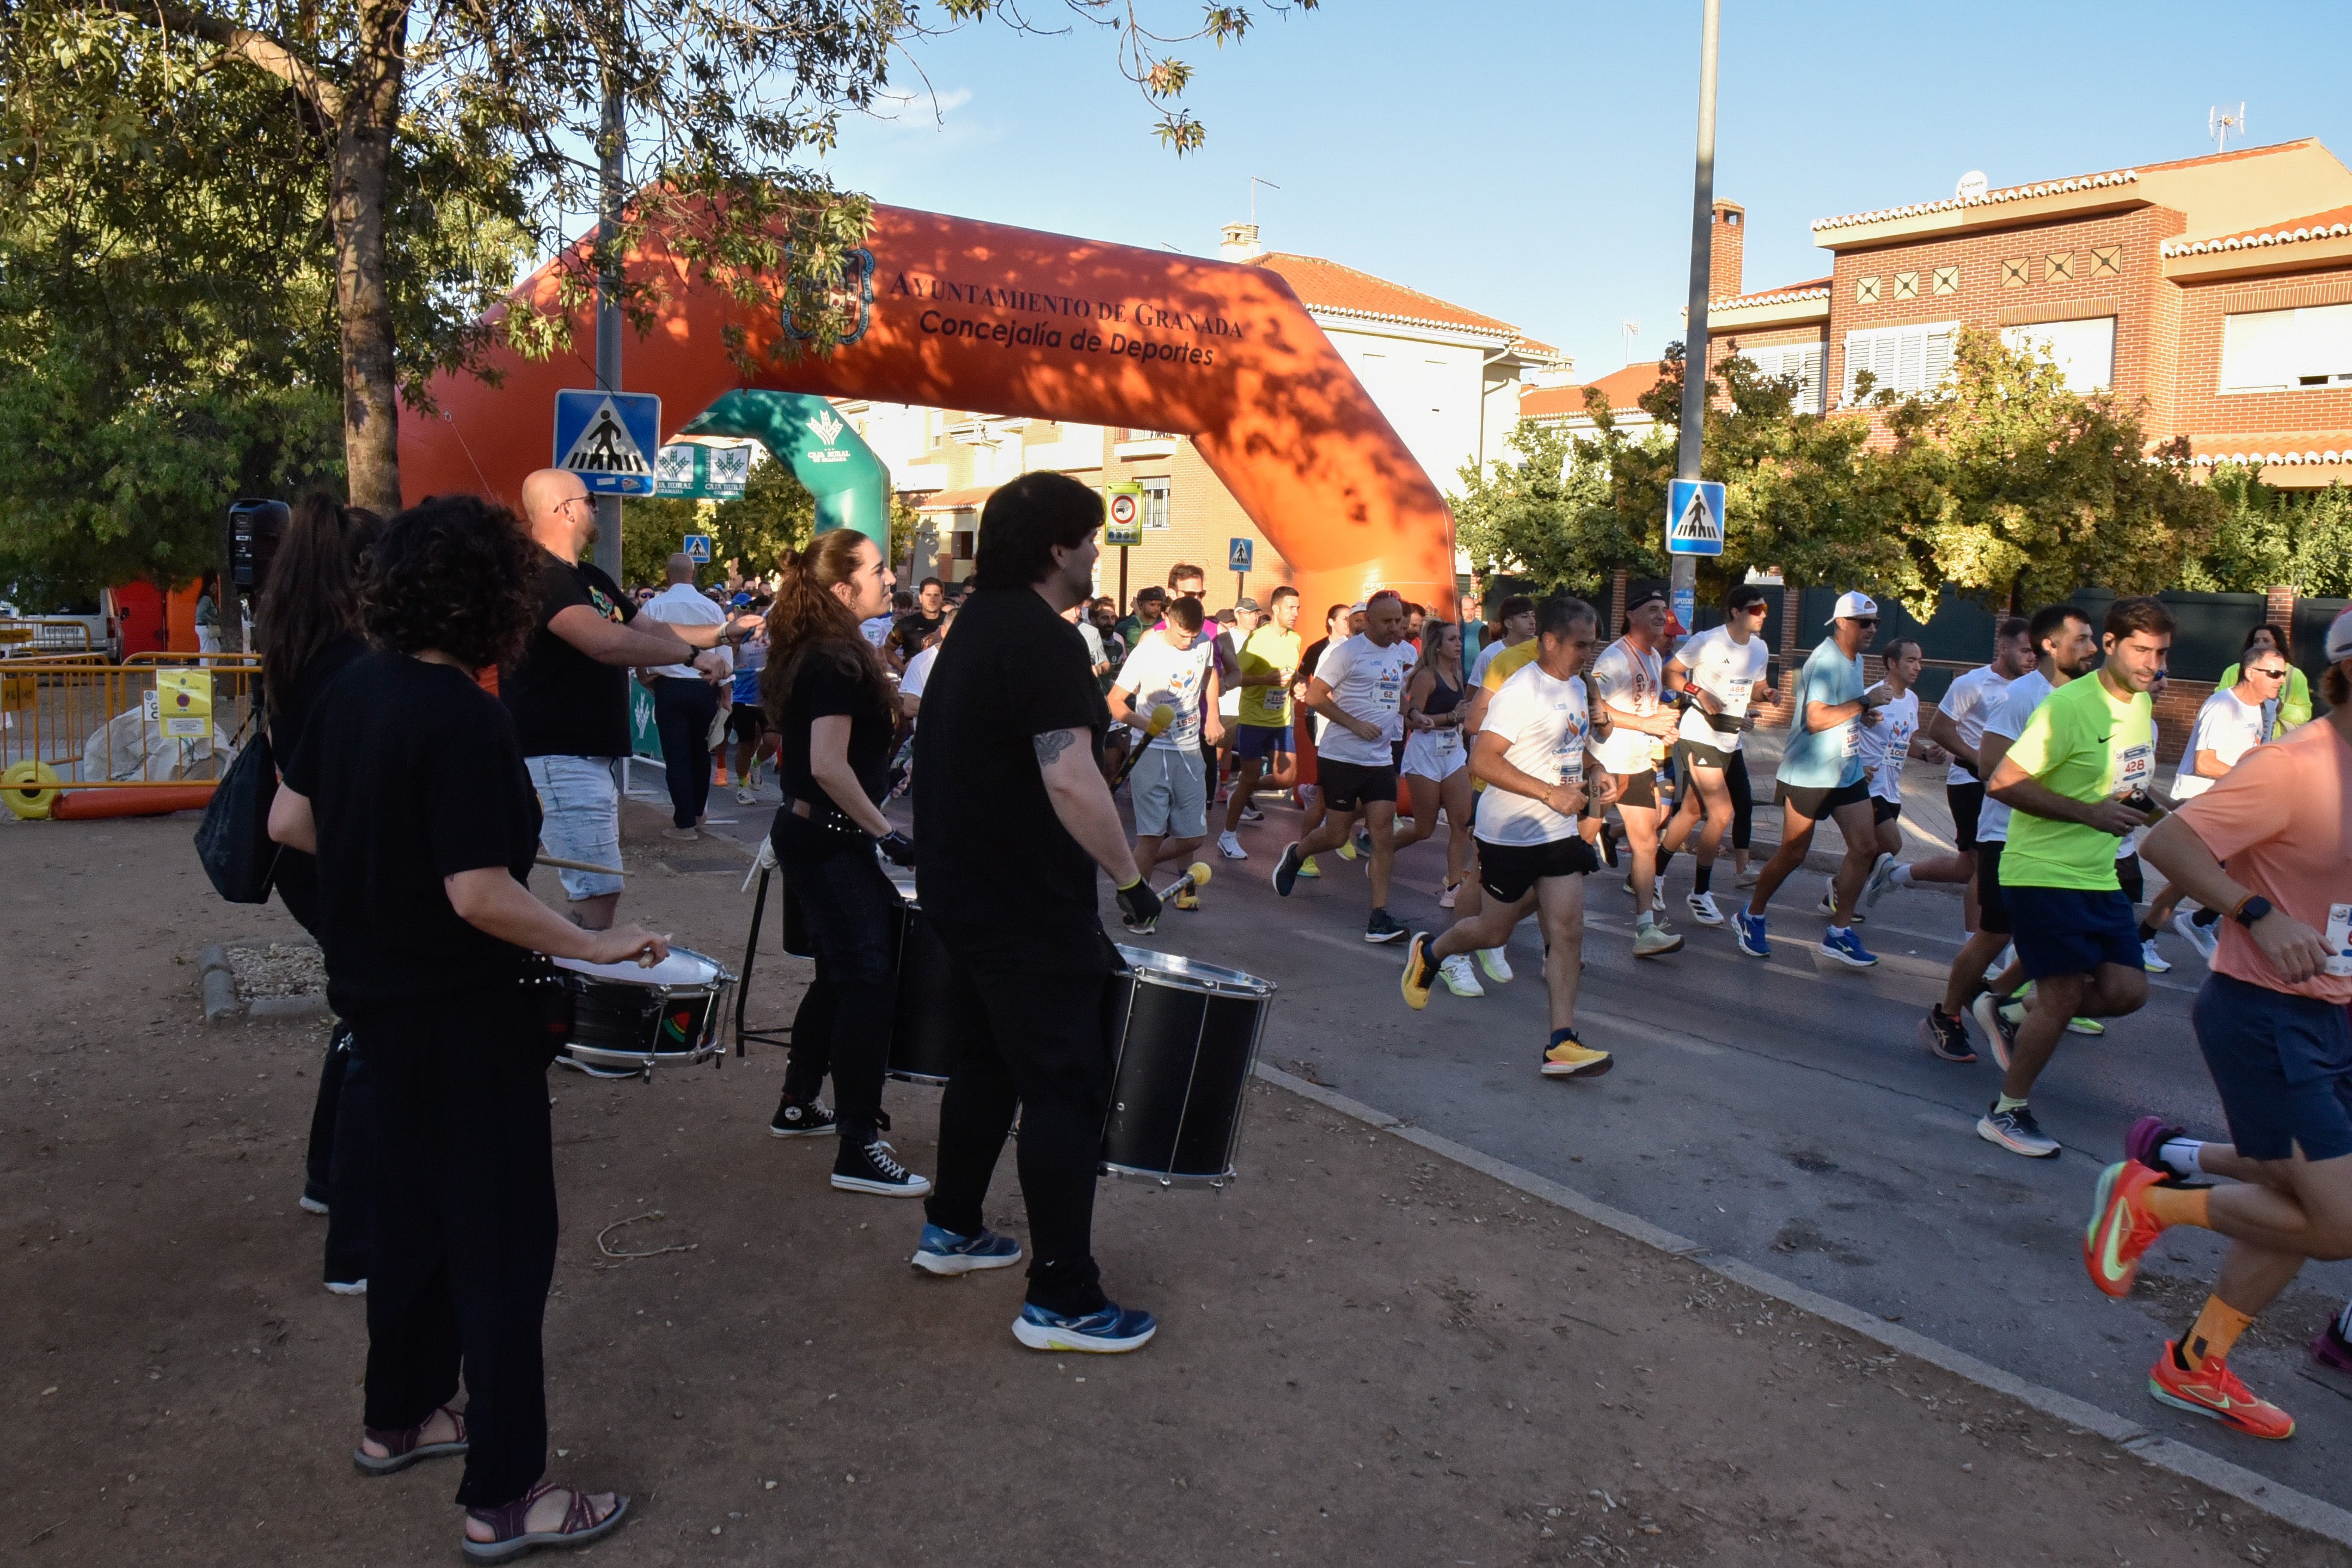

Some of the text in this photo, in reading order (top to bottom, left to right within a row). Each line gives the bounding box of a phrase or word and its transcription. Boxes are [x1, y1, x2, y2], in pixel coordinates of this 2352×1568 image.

[889, 271, 1243, 338] AYUNTAMIENTO DE GRANADA
[919, 309, 1214, 366] Concejalía de Deportes
[1176, 714, 1198, 728] 1589
[2125, 760, 2145, 773] 428
